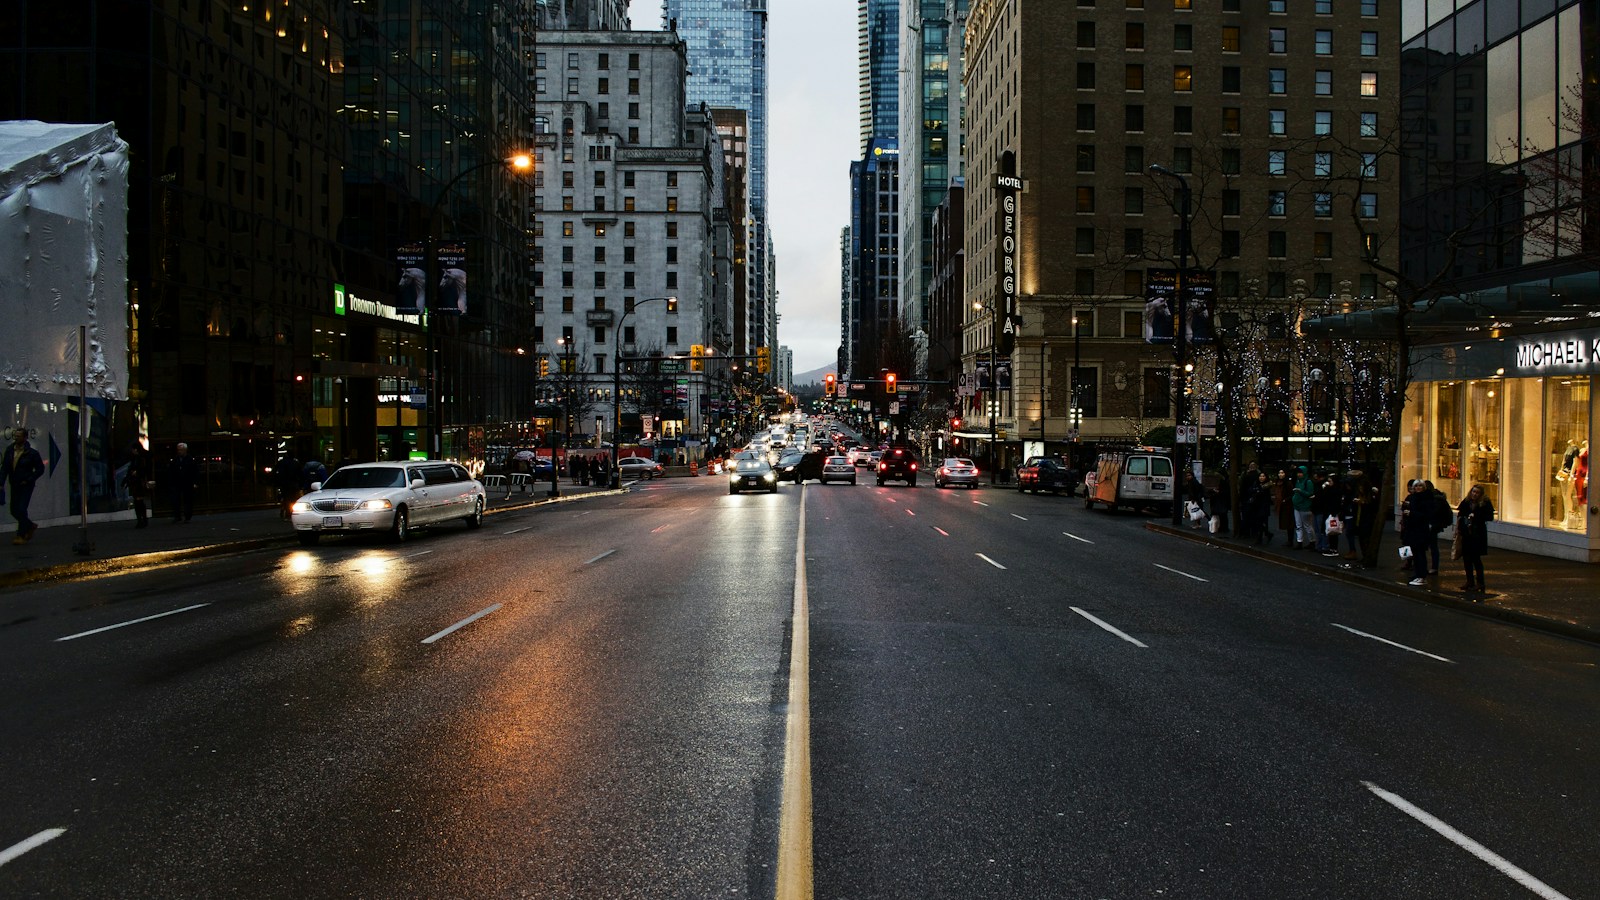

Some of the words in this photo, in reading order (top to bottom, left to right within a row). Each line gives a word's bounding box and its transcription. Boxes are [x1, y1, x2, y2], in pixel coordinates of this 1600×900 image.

[997, 175, 1021, 190] HOTEL
[1002, 195, 1015, 335] GEORGIA
[348, 293, 376, 315] TORONTO
[1516, 341, 1583, 368] MICHAEL
